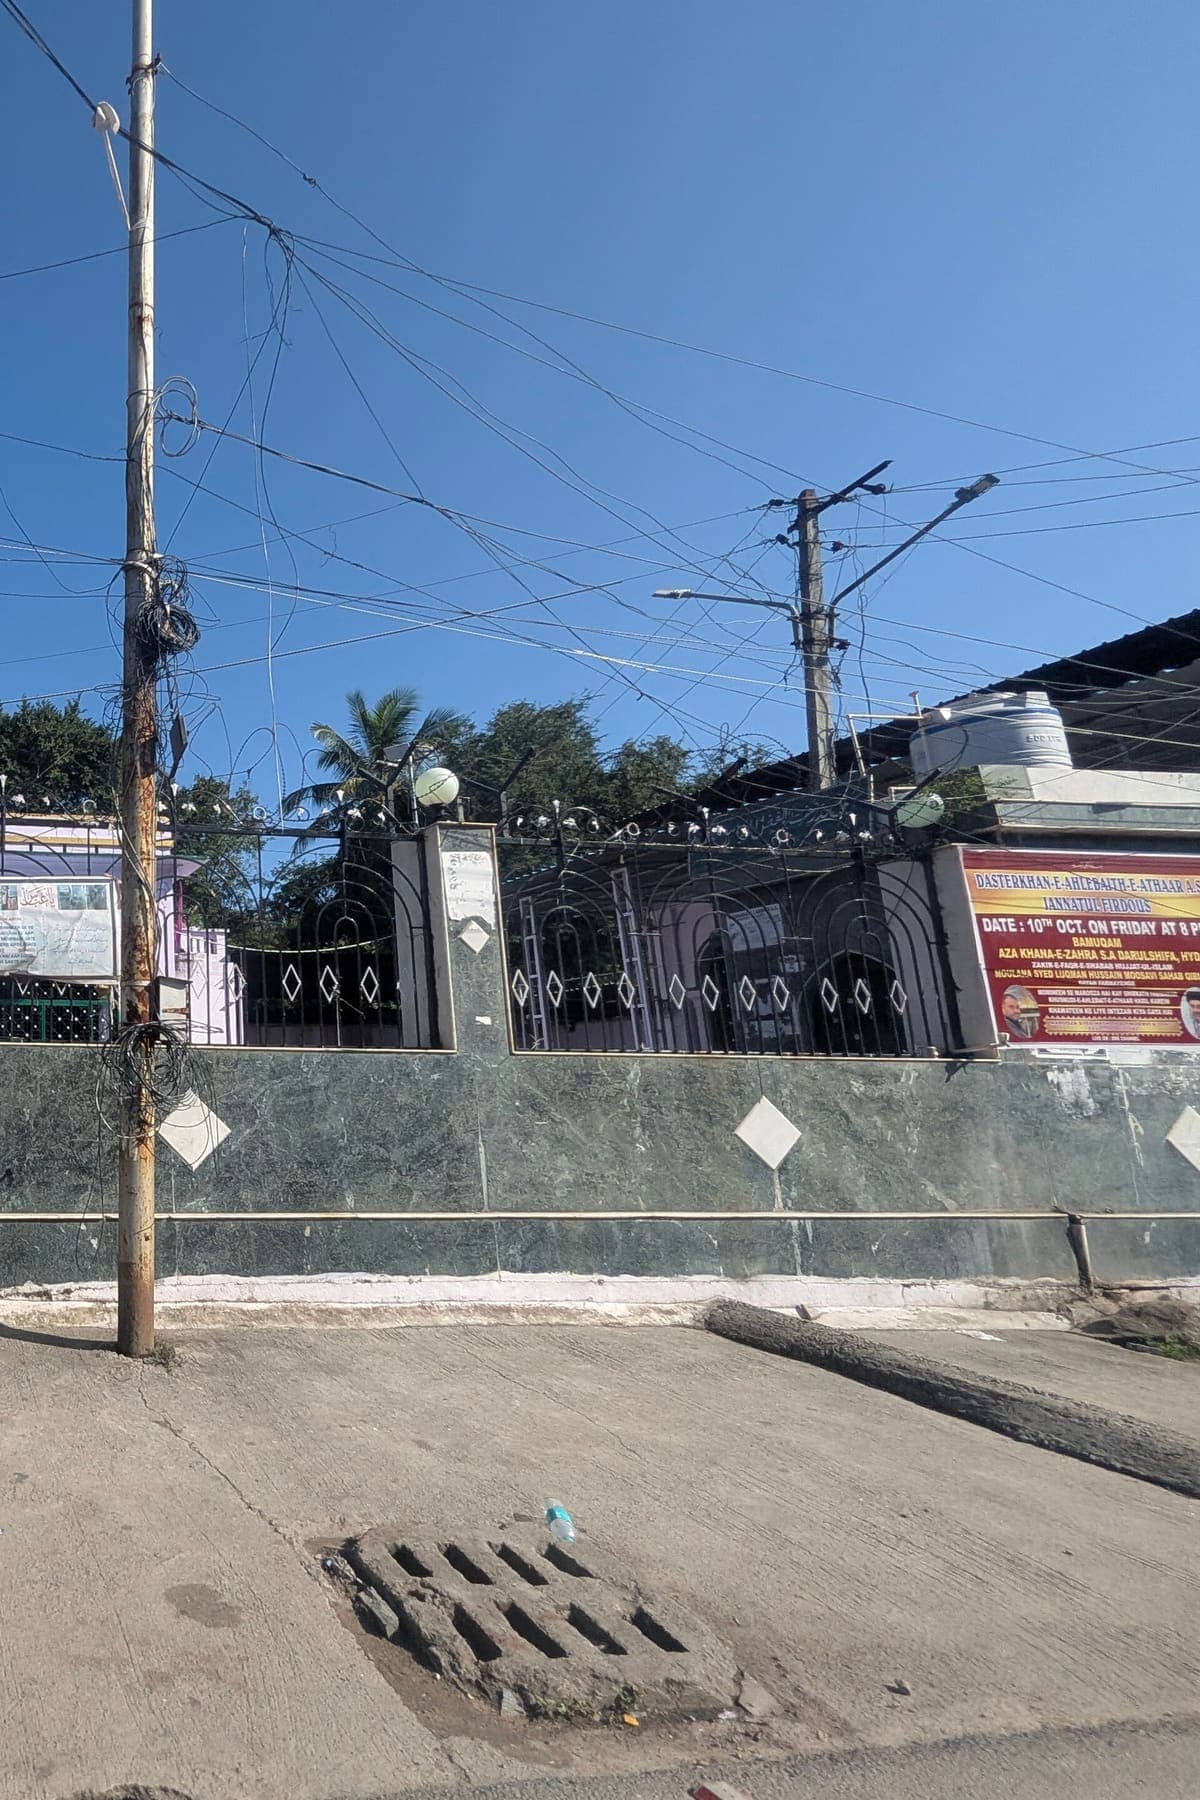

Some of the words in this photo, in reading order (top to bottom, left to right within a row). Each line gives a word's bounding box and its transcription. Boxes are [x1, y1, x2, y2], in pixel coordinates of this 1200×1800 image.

[975, 873, 1184, 893] DASTERKHAN-E-AHLEBAITH-E-ATHAAR
[1101, 898, 1151, 913] FIRDOUS
[982, 917, 1017, 932] DATE
[1057, 919, 1086, 934] OCT.
[1091, 920, 1110, 934] ON
[1112, 920, 1157, 936] FRIDAY
[1161, 921, 1177, 936] AT
[1180, 922, 1188, 936] 8
[1072, 937, 1122, 948] BAMUQAM
[999, 949, 1018, 959] AZA
[1021, 949, 1099, 960] KHANA-E-ZAHRA
[1101, 950, 1117, 960] S.A
[1119, 950, 1181, 963] DARULSHIFA,
[1034, 970, 1054, 979] SYED
[1055, 970, 1087, 979] LUQMAN
[1089, 971, 1124, 980] HUSSAIN
